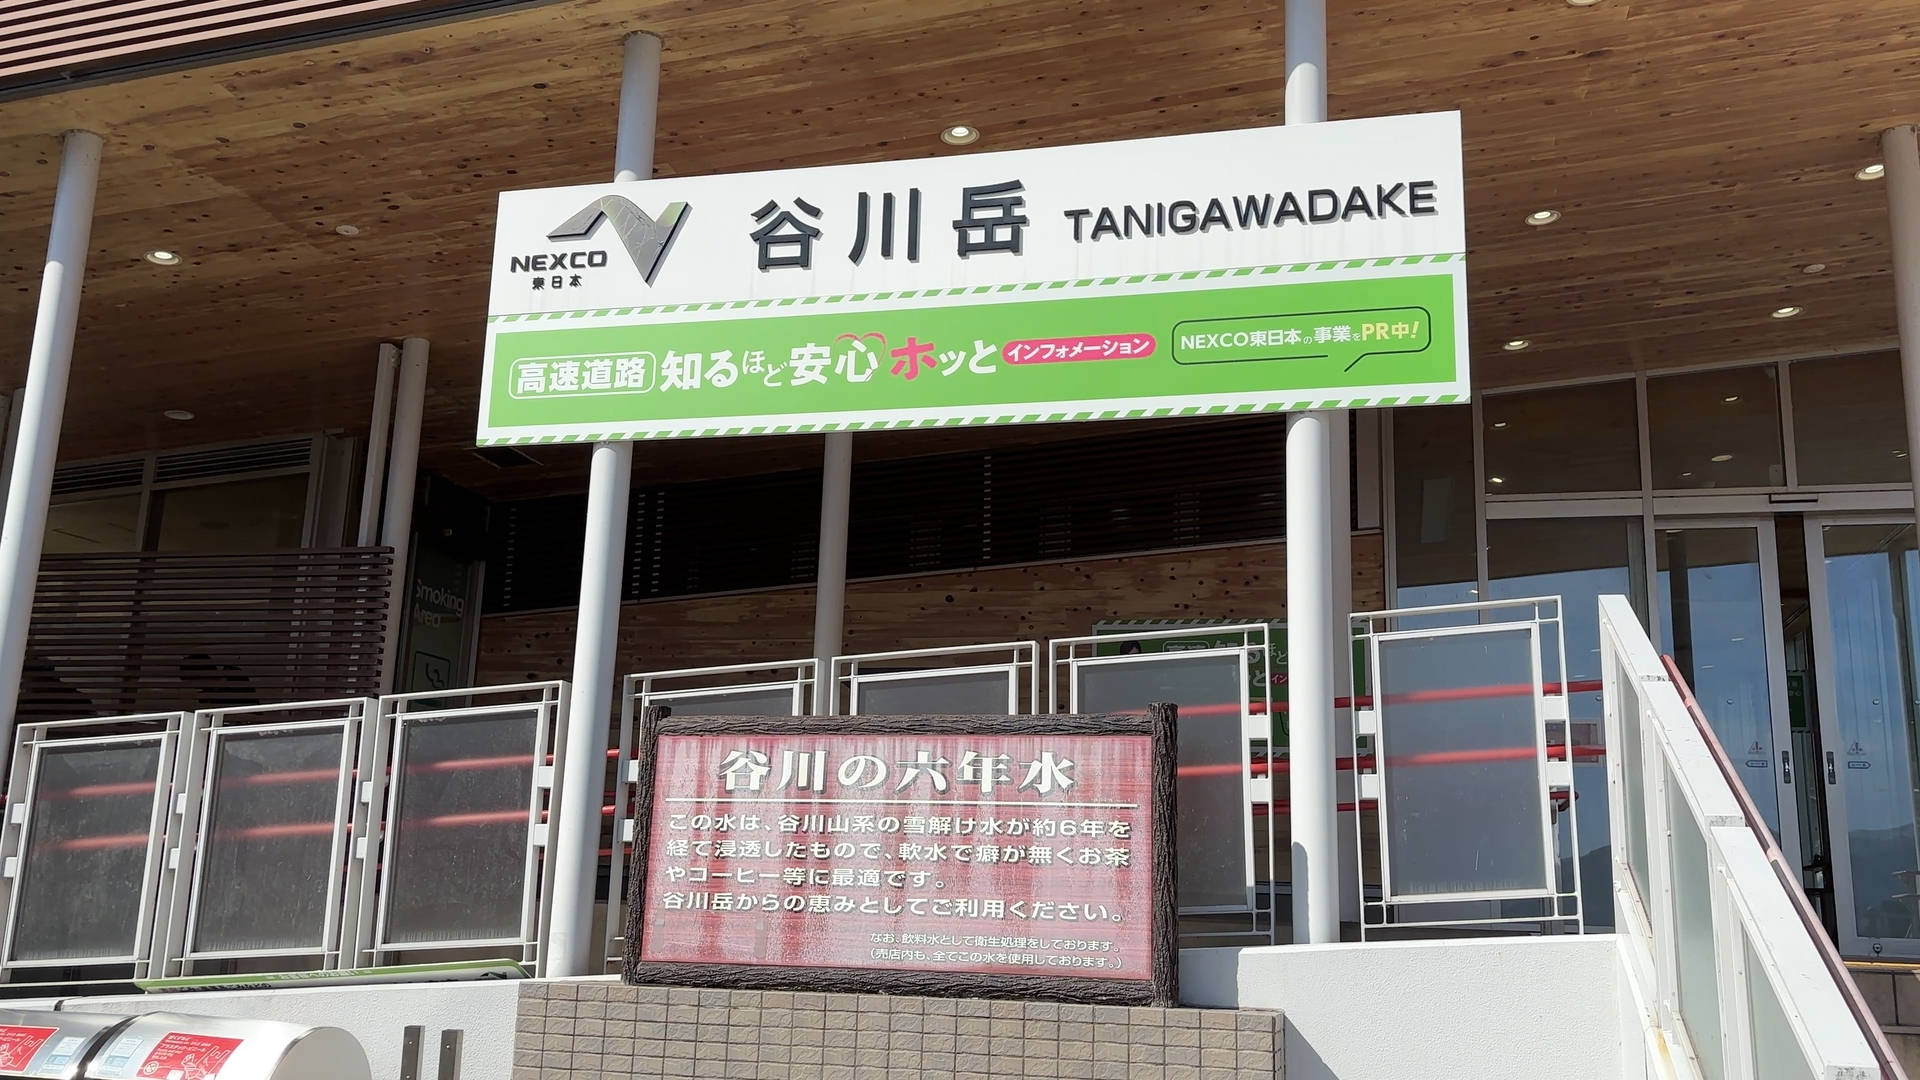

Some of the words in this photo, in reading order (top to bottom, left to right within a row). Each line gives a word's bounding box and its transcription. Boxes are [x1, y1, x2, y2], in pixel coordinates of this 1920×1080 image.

[749, 178, 1029, 271] 谷川岳
[1063, 180, 1439, 243] TANIGAWADAKE
[510, 250, 608, 273] NEXCO
[531, 274, 583, 290] 東日本
[517, 357, 646, 394] 高速道路
[1006, 336, 1150, 362] インフォメーション
[719, 749, 1076, 794] 谷川の六年水
[665, 866, 946, 888] やコーヒー等に最適です。
[662, 891, 1123, 922] 谷川岳からの恵みとしてご利用ください。
